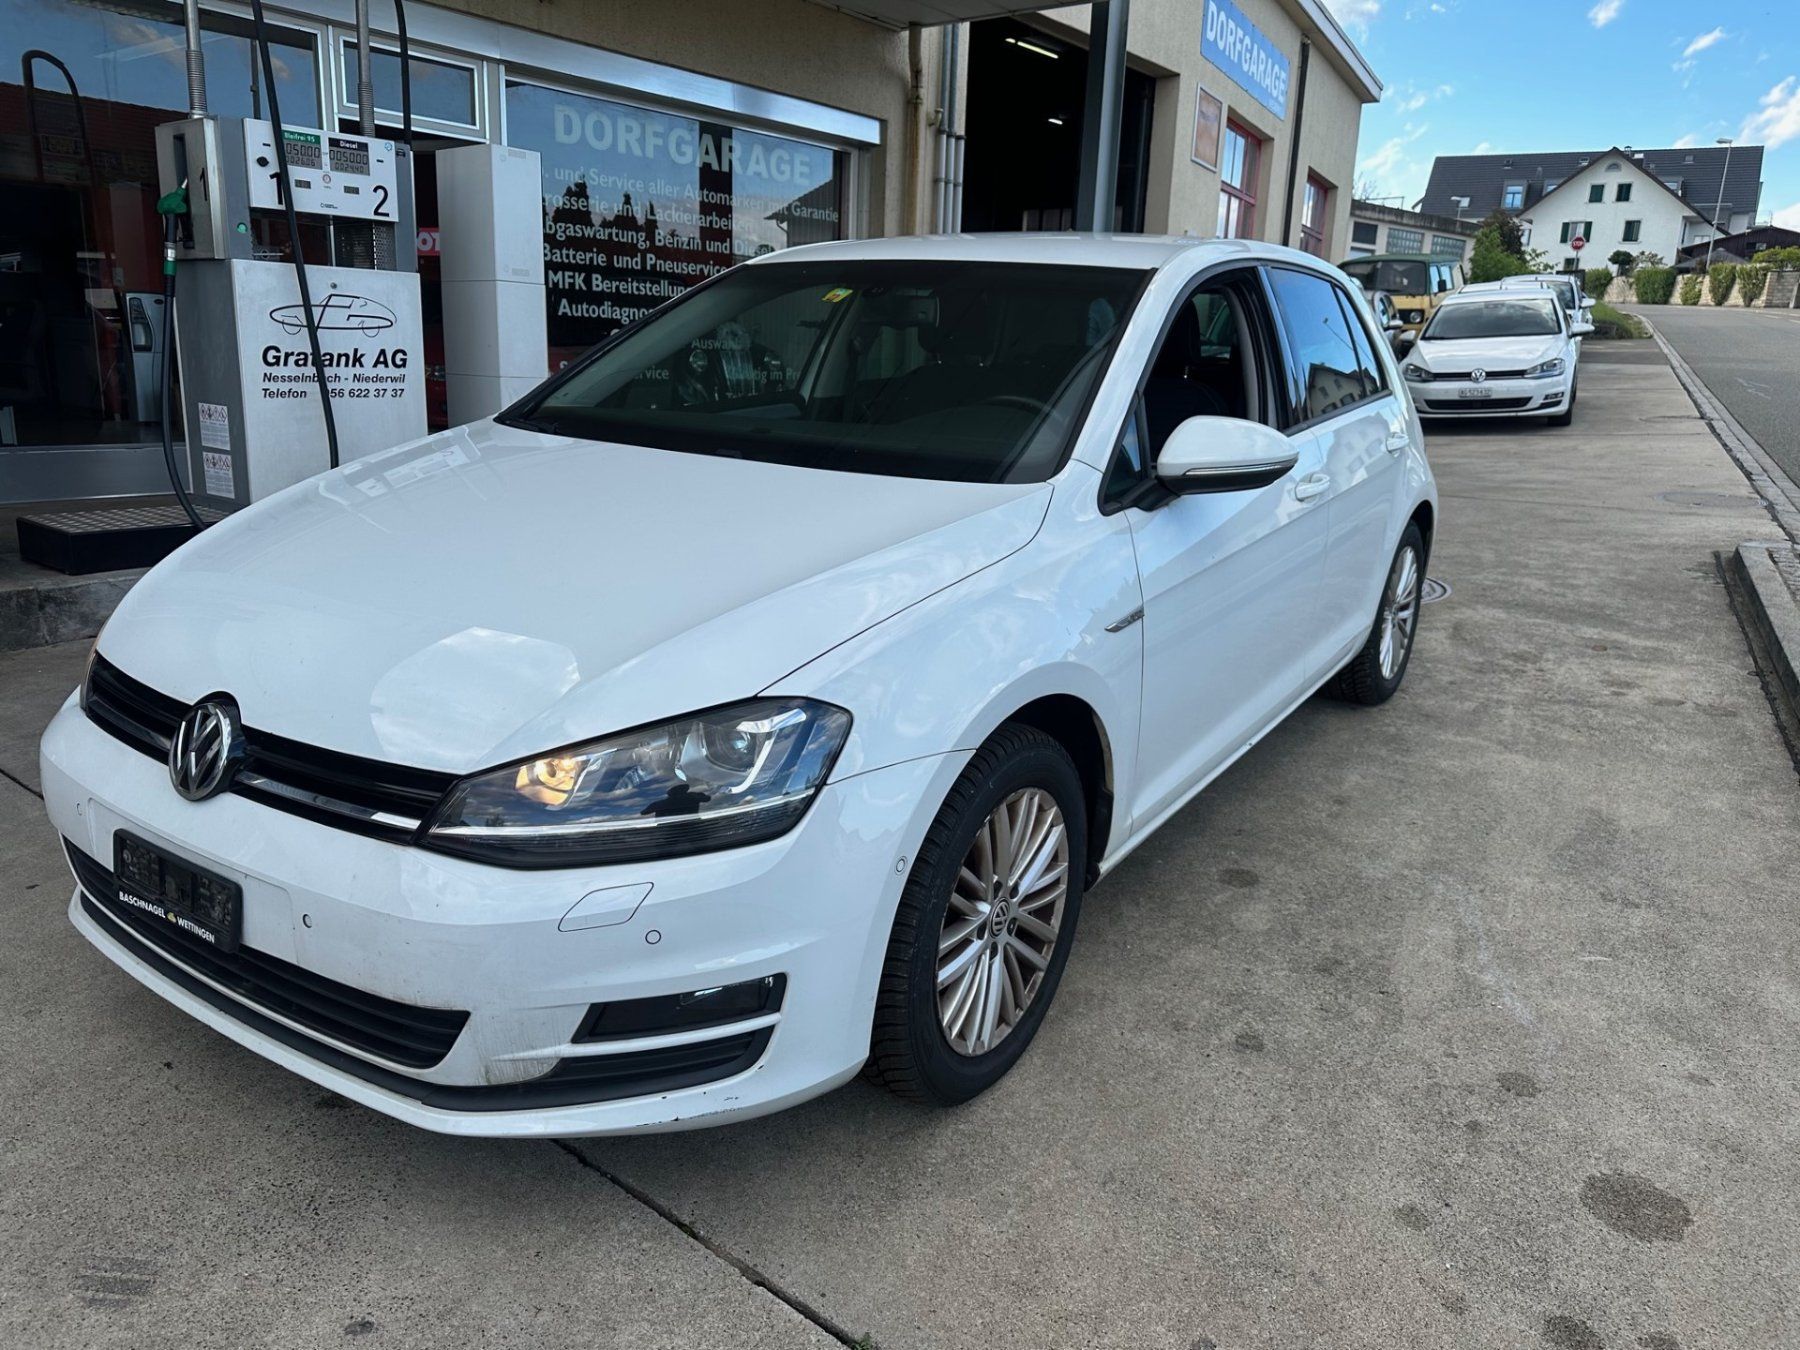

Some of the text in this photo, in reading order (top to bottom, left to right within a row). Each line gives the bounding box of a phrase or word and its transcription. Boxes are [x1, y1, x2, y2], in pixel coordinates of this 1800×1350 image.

[1206, 2, 1287, 101] DORFGARAGE
[340, 140, 358, 149] Diesel
[554, 104, 811, 186] DORFGARAGE
[199, 168, 208, 202] 1
[269, 172, 283, 205] 1
[555, 166, 584, 183] und
[589, 168, 645, 193] Service
[648, 179, 680, 197] aller
[791, 201, 839, 223] Garantie
[372, 184, 390, 217] 2
[542, 193, 609, 214] rosserie
[613, 199, 641, 219] und
[543, 215, 650, 250] bgaswartung,
[655, 228, 702, 250] Benzin
[705, 237, 731, 254] und
[613, 253, 641, 270] und
[548, 270, 690, 297] MFK Bereitstellun
[558, 298, 654, 325] Autodiagno
[262, 345, 408, 369] Graank AG
[262, 372, 341, 384] Nesselnbch
[352, 372, 406, 384] Niederwil
[262, 387, 405, 399] Telefon 56 622 37 37
[118, 890, 216, 944] BASCHNAGEL WETTINGEN
